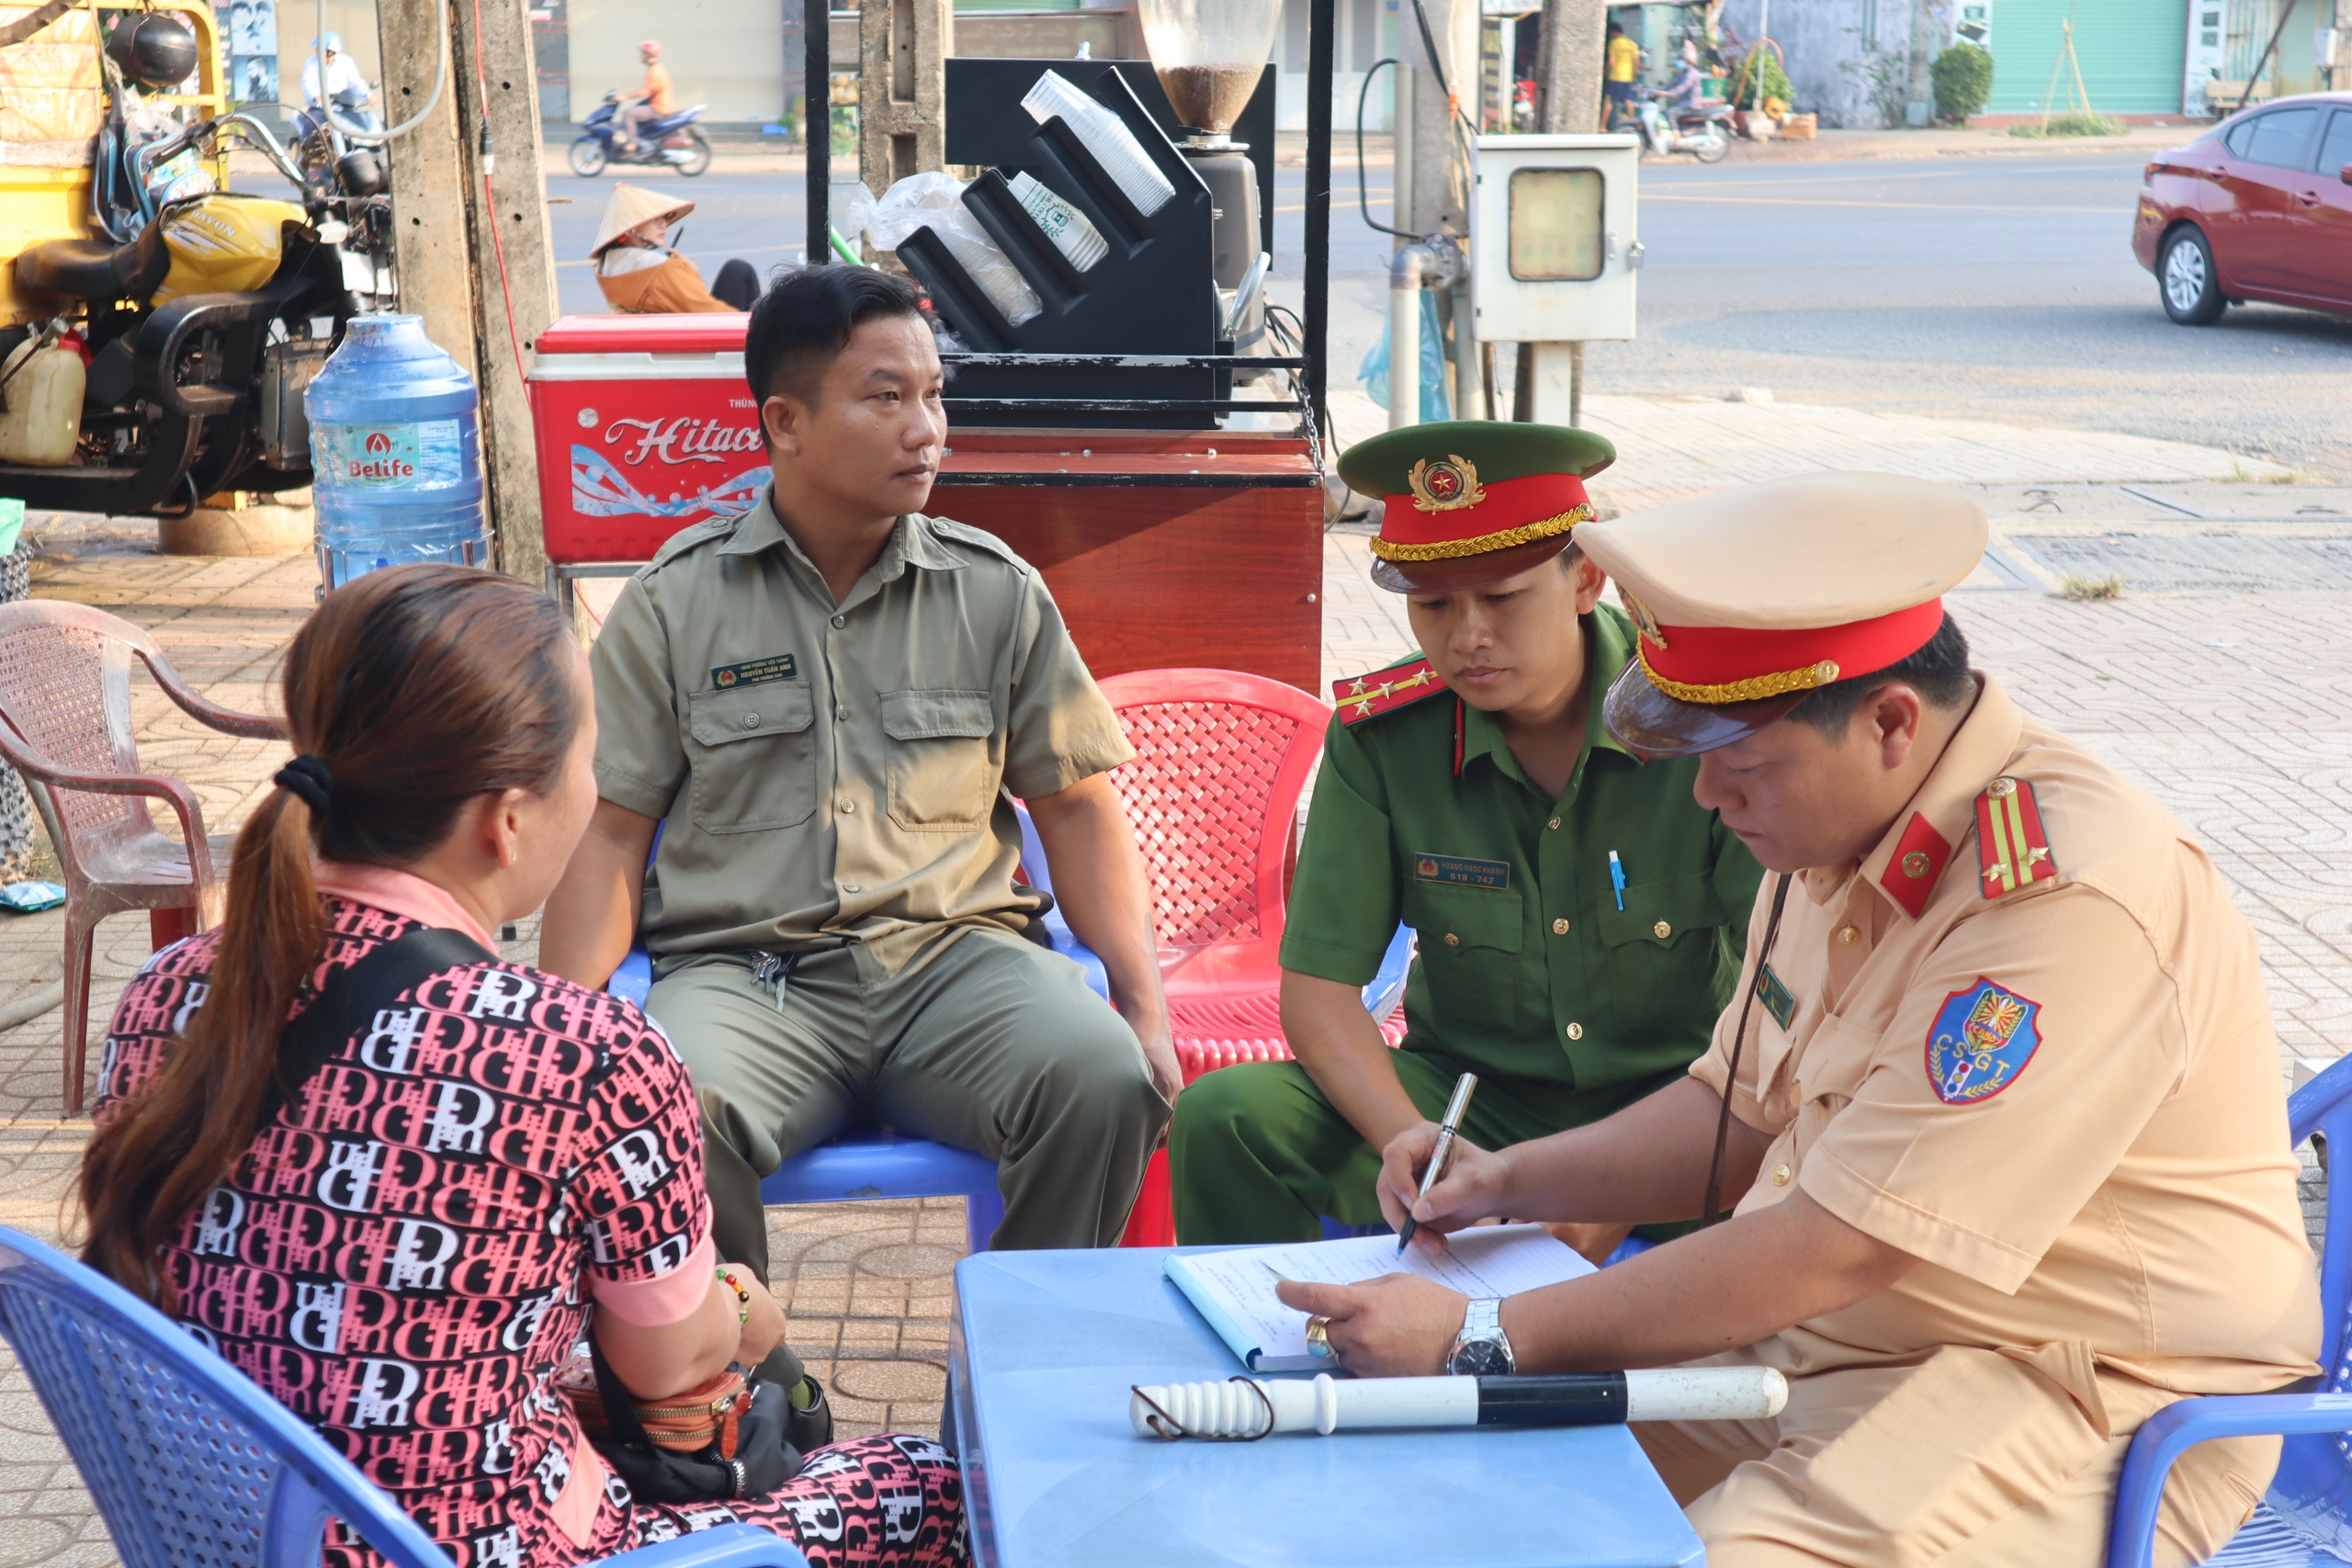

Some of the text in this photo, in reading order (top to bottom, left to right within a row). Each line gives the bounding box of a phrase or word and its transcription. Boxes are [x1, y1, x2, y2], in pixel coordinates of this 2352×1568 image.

[190, 209, 236, 237] DAYUN
[348, 458, 413, 478] Belife
[1441, 862, 1464, 871] HOÀNG
[1464, 864, 1482, 874] NGỌC
[1451, 873, 1467, 881] 518
[1477, 875, 1494, 884] 742
[1973, 1025, 1996, 1043] CAND
